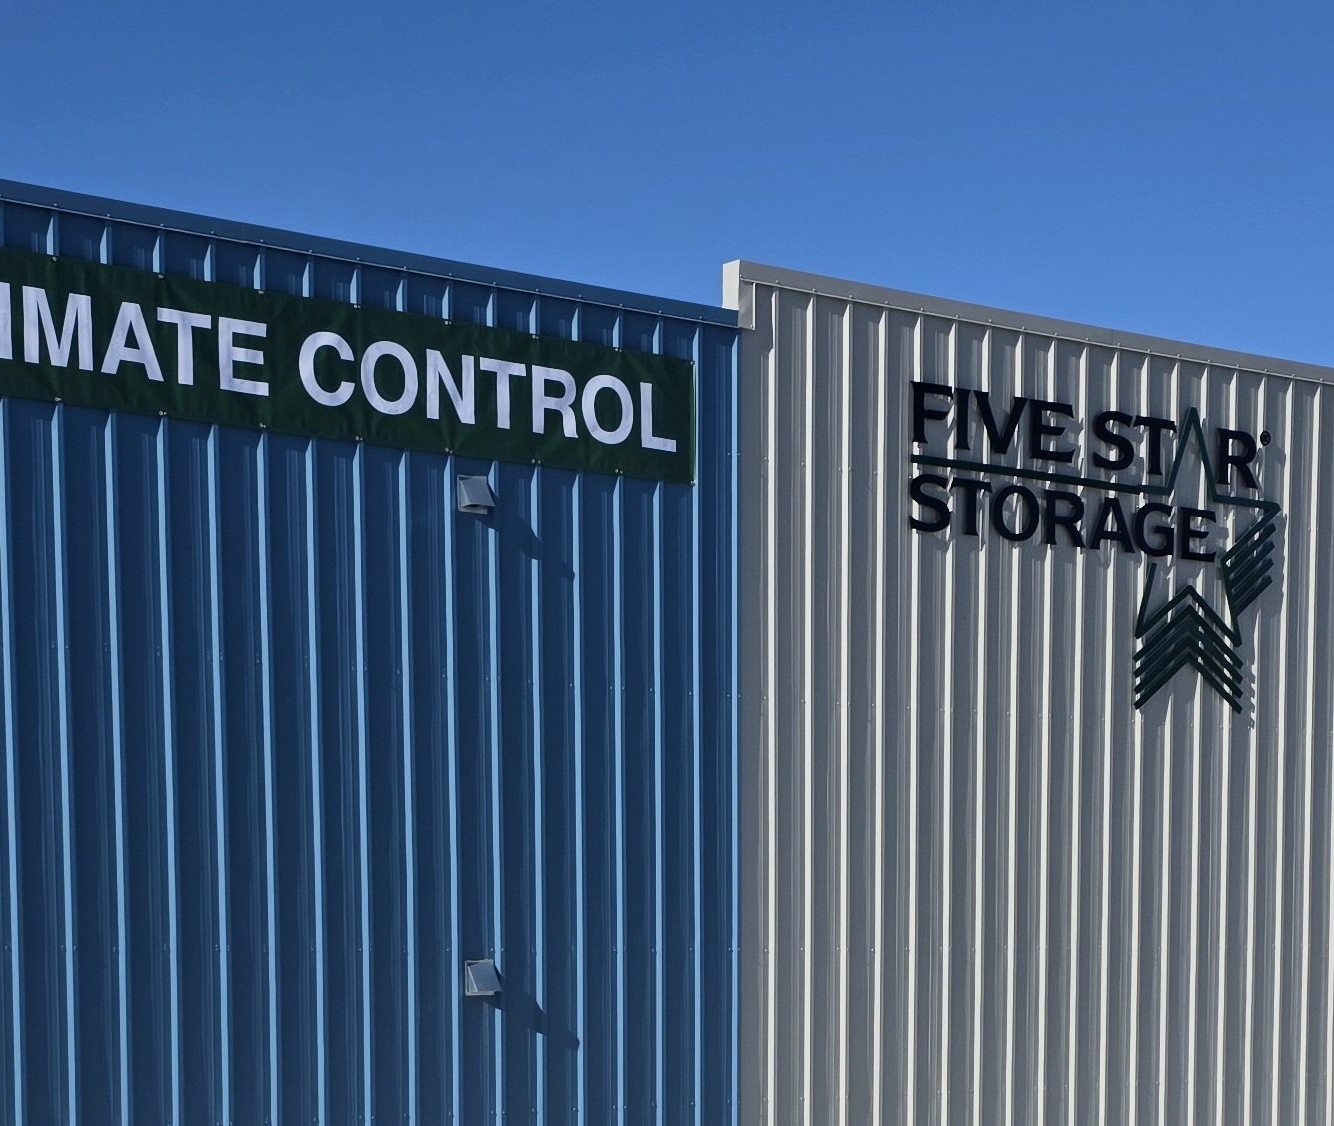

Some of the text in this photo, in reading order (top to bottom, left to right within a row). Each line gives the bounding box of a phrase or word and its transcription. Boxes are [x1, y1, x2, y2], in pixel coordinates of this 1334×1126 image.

[297, 330, 678, 453] CONTROL
[910, 380, 1075, 464] FIVE
[909, 473, 1218, 563] STORAGE
